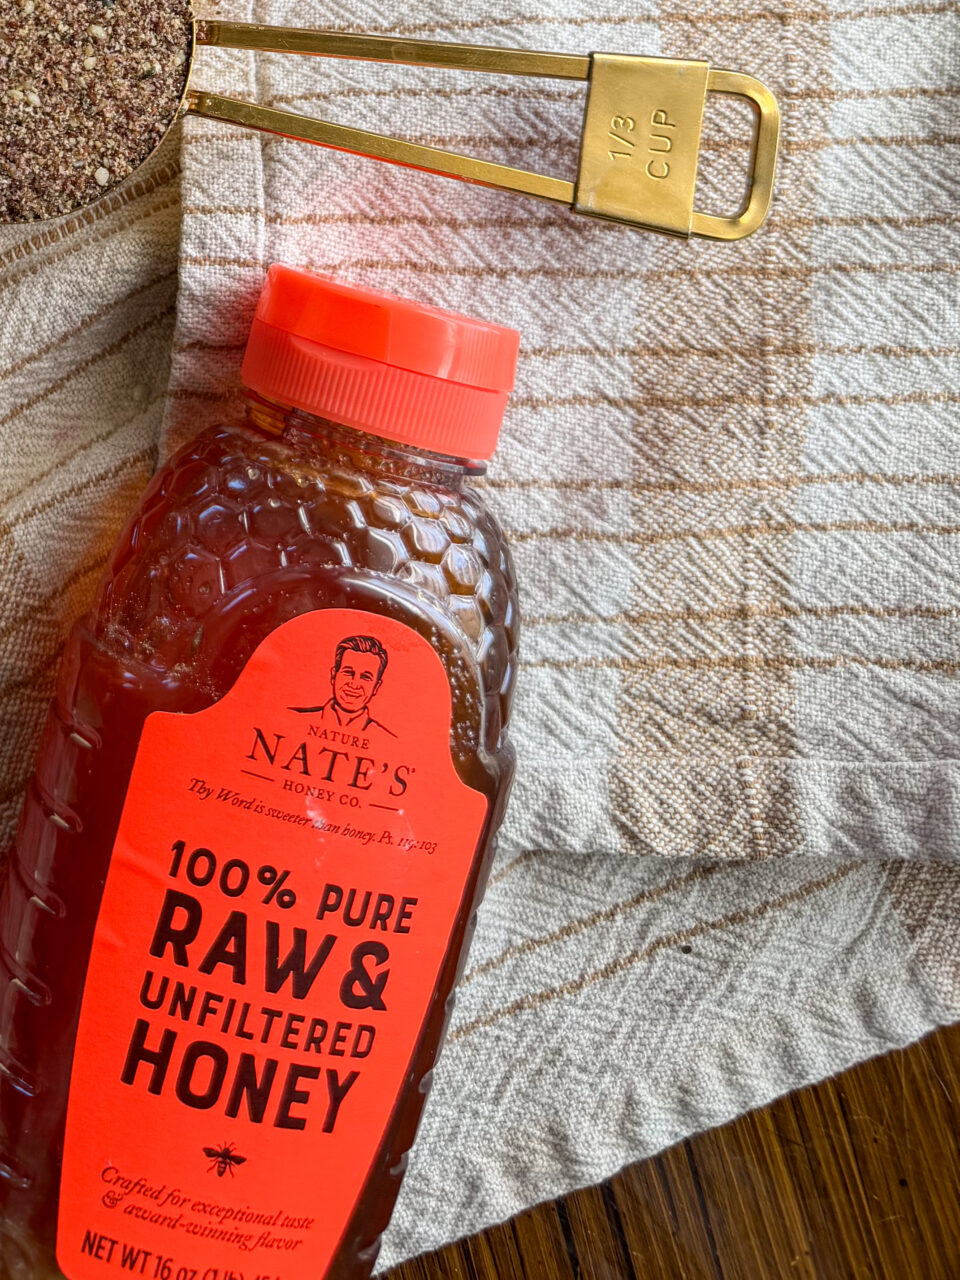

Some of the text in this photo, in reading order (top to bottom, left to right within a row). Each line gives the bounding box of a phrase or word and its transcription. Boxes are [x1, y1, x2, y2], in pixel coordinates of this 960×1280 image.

[607, 115, 636, 161] 1/3
[646, 109, 676, 181] CUP
[245, 727, 411, 798] NATE'S
[307, 725, 370, 750] NATURE
[188, 777, 213, 801] Thy
[216, 787, 253, 810] Word
[254, 799, 265, 814] is
[265, 806, 312, 828] sweeter
[343, 823, 376, 845] honey.
[282, 779, 362, 809] HONEY CO.
[168, 839, 418, 934] 100% PURE
[140, 970, 376, 1058] UNFILTERED
[120, 1018, 360, 1134] HONEY
[101, 1165, 315, 1230] Crafted for exceptional taste
[102, 1190, 303, 1252] & award-winning flavor
[81, 1230, 118, 1263] NET
[121, 1246, 152, 1274] WT
[153, 1255, 173, 1280] 16
